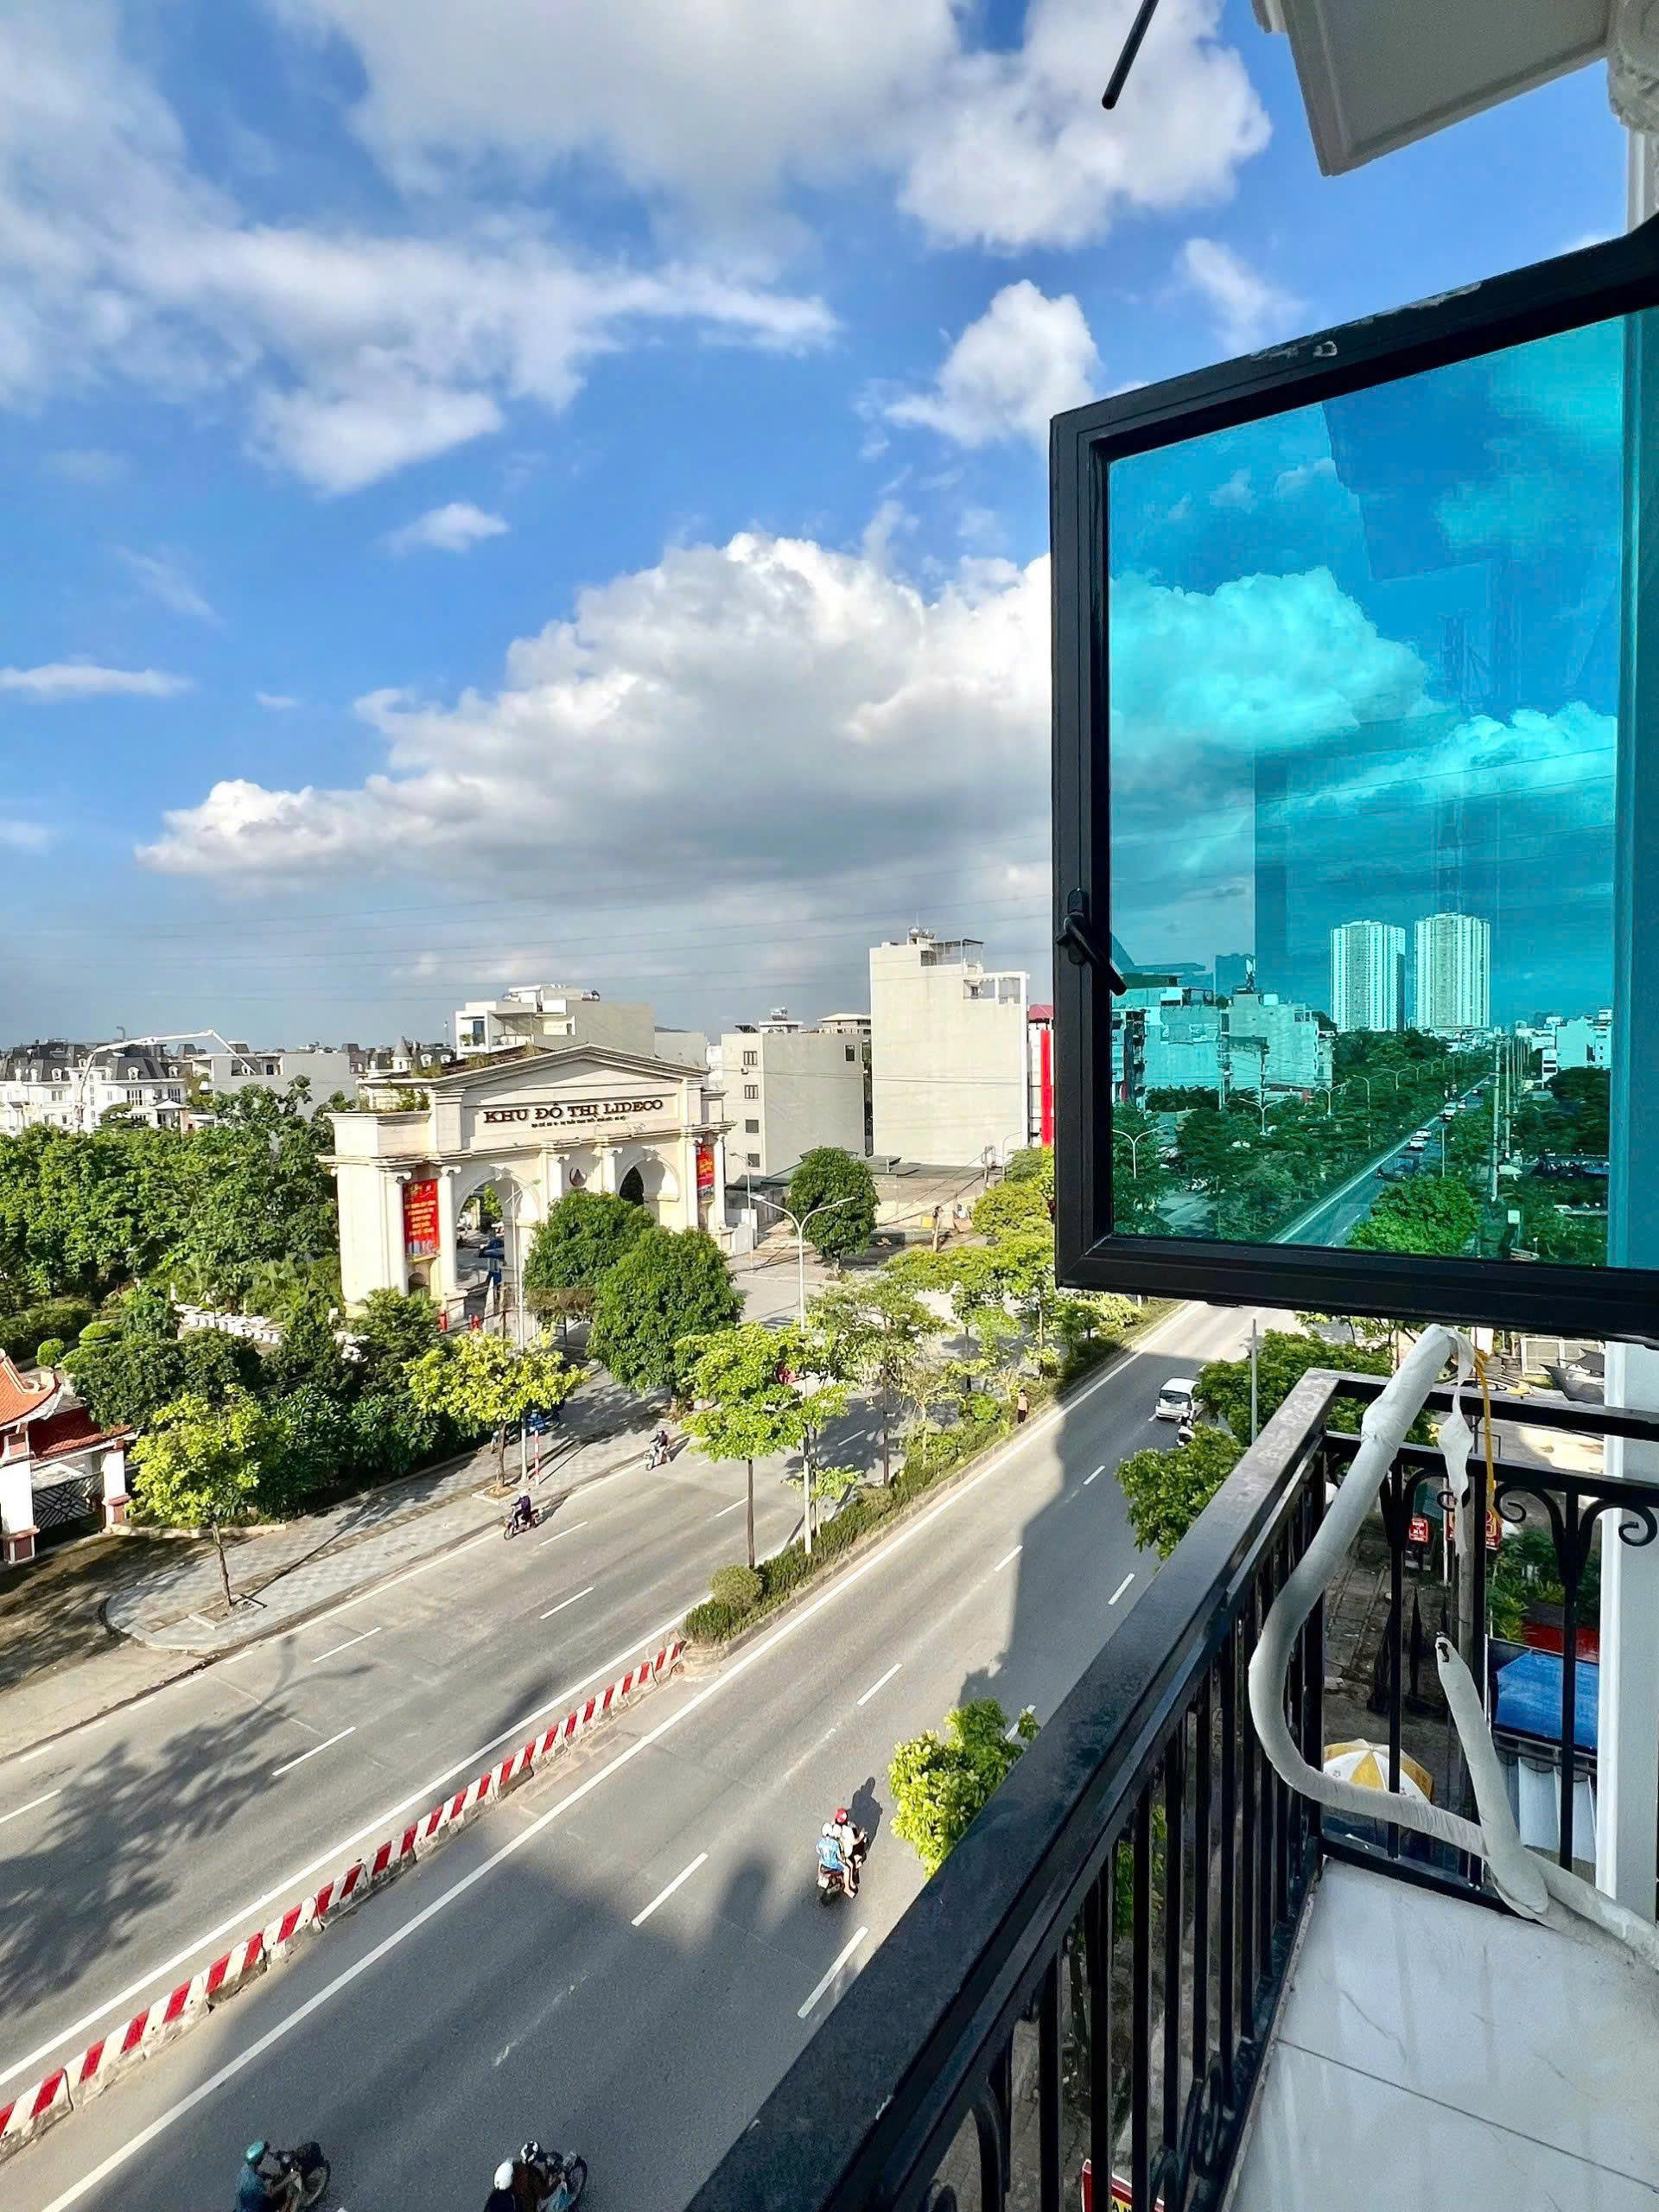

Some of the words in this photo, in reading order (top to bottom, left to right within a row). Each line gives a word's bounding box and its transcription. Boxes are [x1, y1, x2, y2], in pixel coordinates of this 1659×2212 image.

[484, 1109, 529, 1123] KHU
[534, 1103, 563, 1120] ĐÔ
[568, 1104, 600, 1119] THỊ
[604, 1099, 664, 1115] LIDECO
